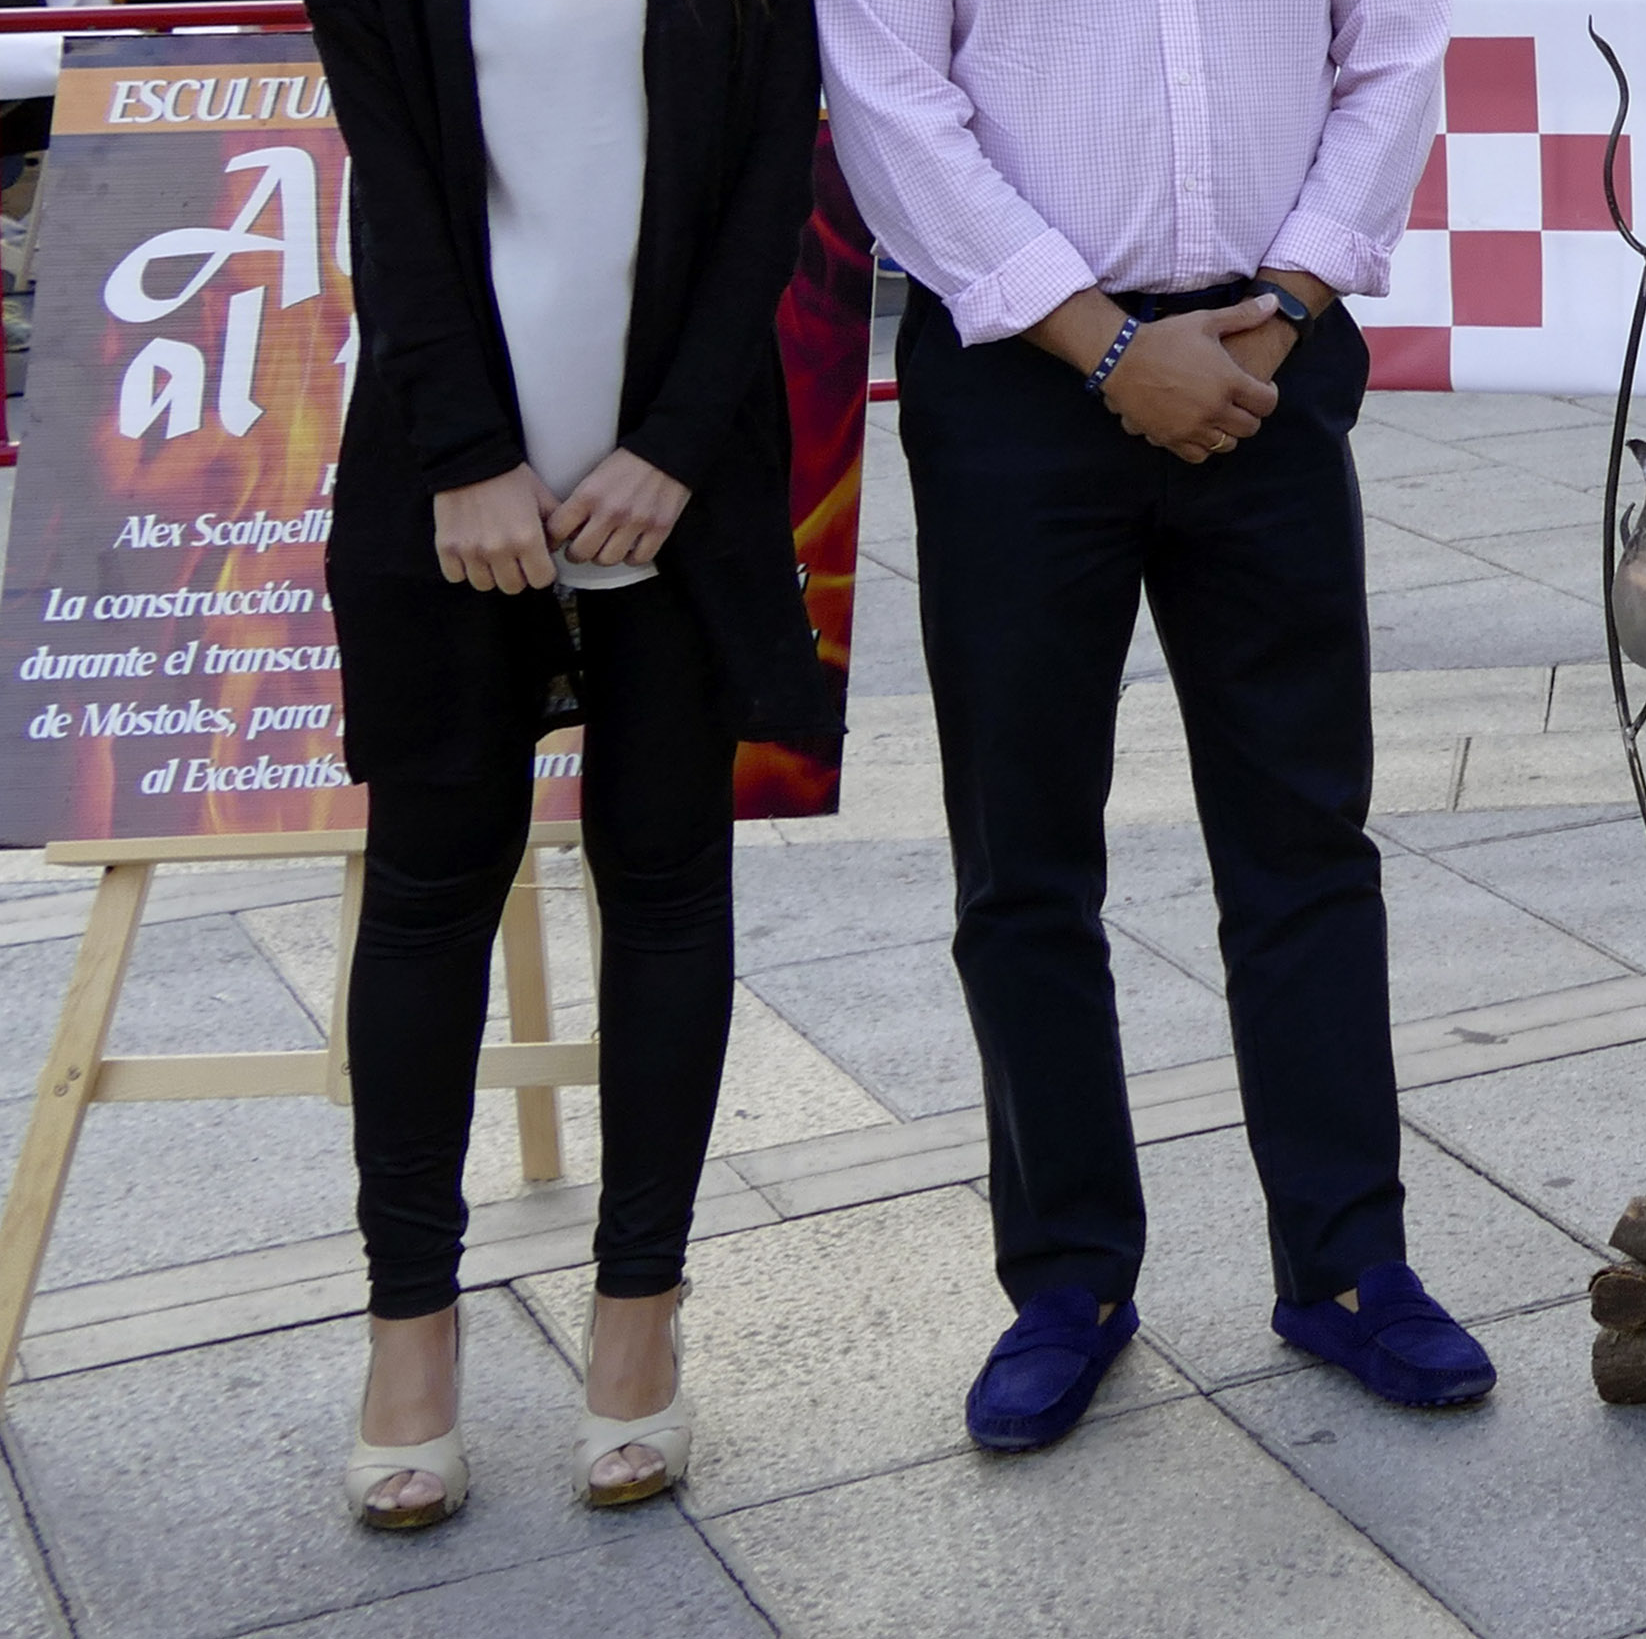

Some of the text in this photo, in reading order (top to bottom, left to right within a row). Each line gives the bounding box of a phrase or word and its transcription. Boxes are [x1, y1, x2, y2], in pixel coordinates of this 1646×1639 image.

[119, 285, 265, 440] al
[112, 513, 186, 549] Alex
[44, 587, 86, 622] La
[93, 580, 314, 619] construcción
[19, 644, 157, 681] durante
[164, 640, 200, 676] el
[28, 703, 72, 740] de
[79, 698, 237, 739] Móstoles,
[246, 703, 332, 740] para
[140, 758, 180, 795] al
